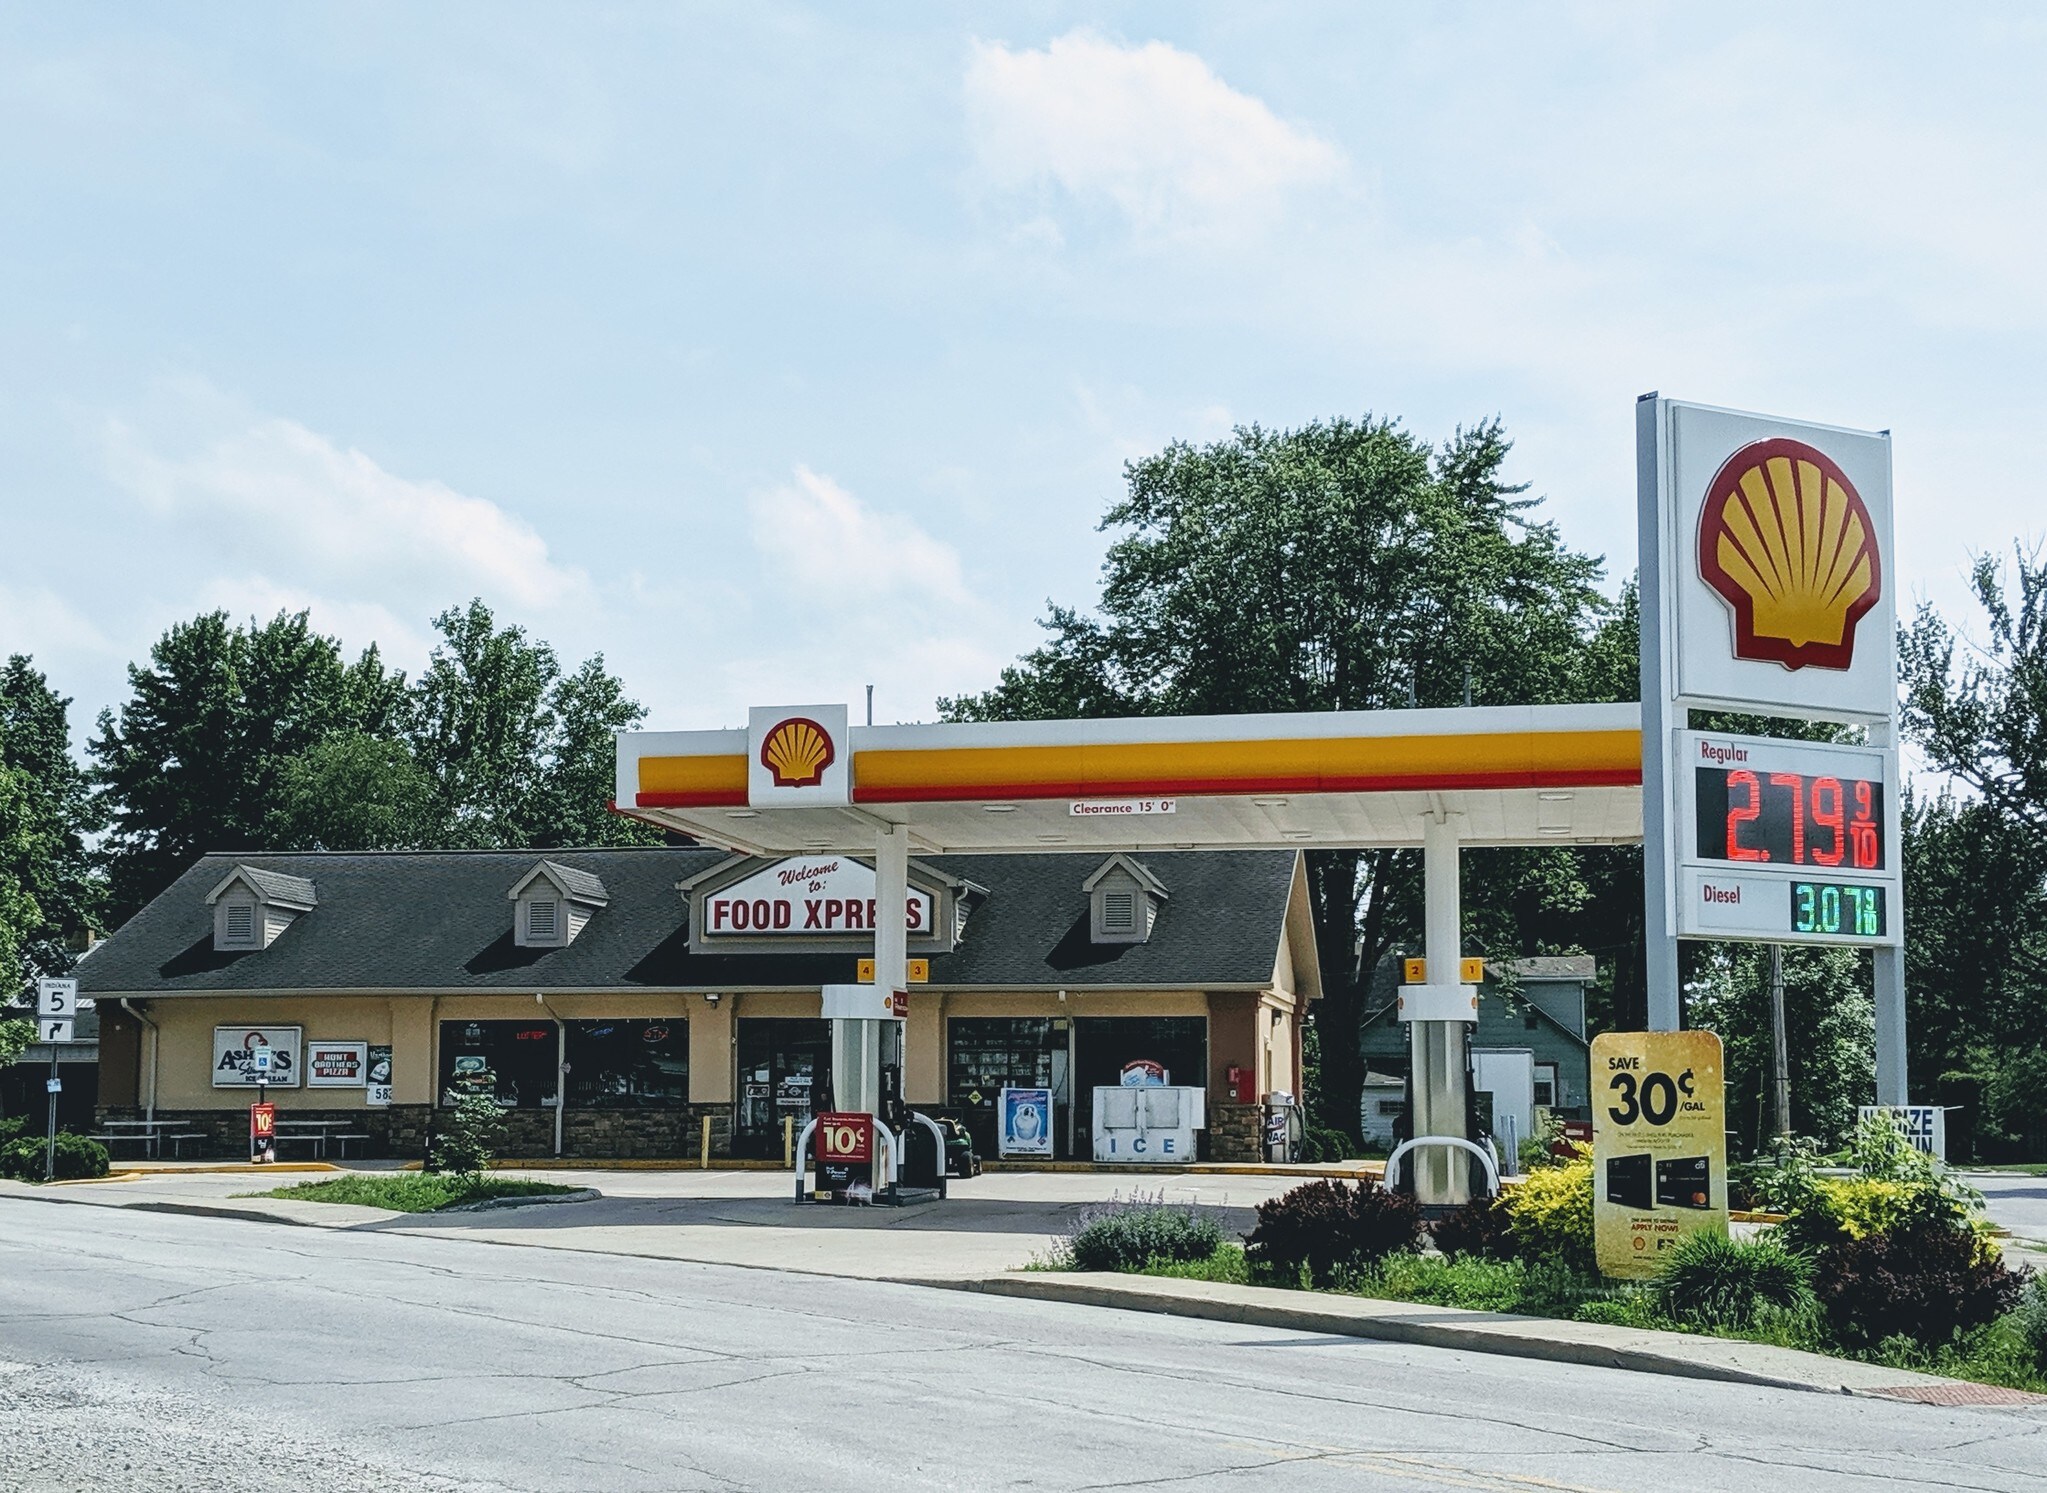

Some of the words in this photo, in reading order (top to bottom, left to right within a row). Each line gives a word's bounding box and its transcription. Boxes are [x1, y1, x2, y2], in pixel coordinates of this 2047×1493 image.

[1701, 741, 1748, 764] Regular
[1073, 803, 1132, 814] Clearance
[1139, 802, 1155, 812] 15'
[1726, 769, 1844, 866] 2.79
[778, 861, 839, 886] Welcome
[808, 880, 827, 893] to:
[1703, 884, 1740, 904] Diesel
[714, 899, 791, 930] FOOD
[803, 898, 922, 929] XPRES
[1796, 883, 1862, 934] 3.07
[914, 966, 921, 975] 3
[1412, 966, 1419, 974] 2
[51, 992, 64, 1011] 5
[1608, 1057, 1639, 1070] SAVE
[1680, 1101, 1705, 1111] /GAL
[1267, 1117, 1284, 1126] AIR
[1110, 1138, 1175, 1153] ICE
